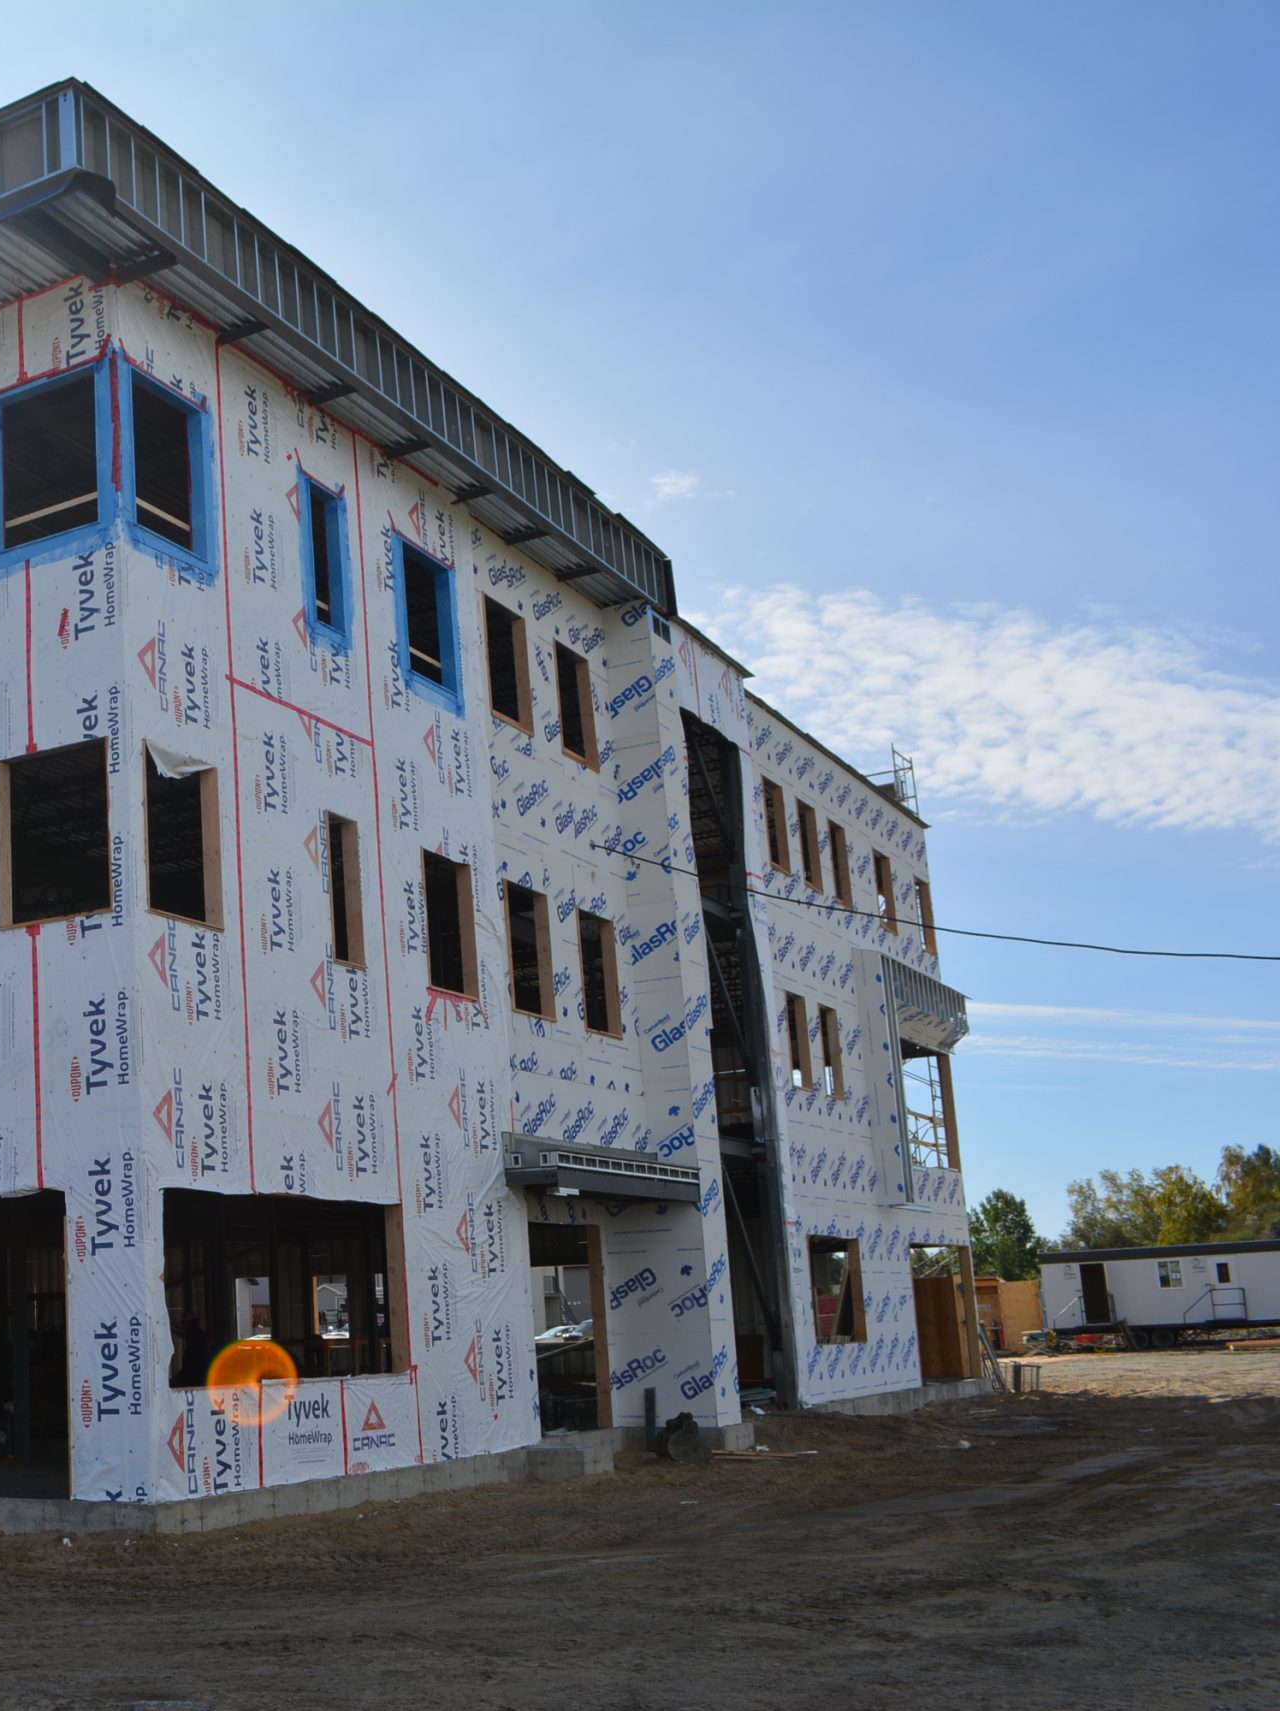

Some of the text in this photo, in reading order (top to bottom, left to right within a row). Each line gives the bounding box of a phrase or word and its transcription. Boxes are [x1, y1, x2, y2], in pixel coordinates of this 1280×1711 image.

[65, 282, 91, 366] Tyvek
[247, 384, 263, 456] Tyvek
[103, 541, 115, 626] HomeWrap
[250, 509, 268, 583] Tyvek
[72, 550, 98, 641] Tyvek
[181, 643, 202, 725] Tyvek
[108, 686, 120, 774] HomeWrap
[451, 729, 466, 795] Tyvek
[263, 733, 280, 812] Tyvek
[396, 759, 409, 830] Tyvek
[112, 836, 124, 927] HomeWrap
[267, 869, 285, 951] Tyvek
[286, 871, 295, 952] HomeWrap
[404, 881, 419, 954] Tyvek
[191, 933, 212, 1021] Tyvek
[83, 998, 114, 1095] Tyvek
[116, 991, 129, 1084] HomeWrap
[273, 1010, 292, 1095] Tyvek
[412, 1006, 425, 1081] Tyvek
[198, 1084, 218, 1177] Tyvek
[353, 1096, 370, 1178] Tyvek
[477, 1082, 491, 1153] Tyvek
[88, 1158, 119, 1256] Tyvek
[121, 1152, 135, 1247] HomeWrap
[420, 1136, 436, 1212] Tyvek
[483, 1203, 498, 1277] Tyvek
[497, 1201, 507, 1272] HomeWrap
[428, 1266, 444, 1347] Tyvek
[94, 1321, 126, 1422] Tyvek
[128, 1317, 142, 1415] HomeWrap
[492, 1329, 507, 1405] Tyvek
[505, 1325, 514, 1398] HomeWrap
[211, 1396, 232, 1495] Tyvek
[232, 1393, 241, 1486] HomeWrap
[286, 1394, 330, 1427] Tyvek
[289, 1431, 332, 1445] HomeWrap
